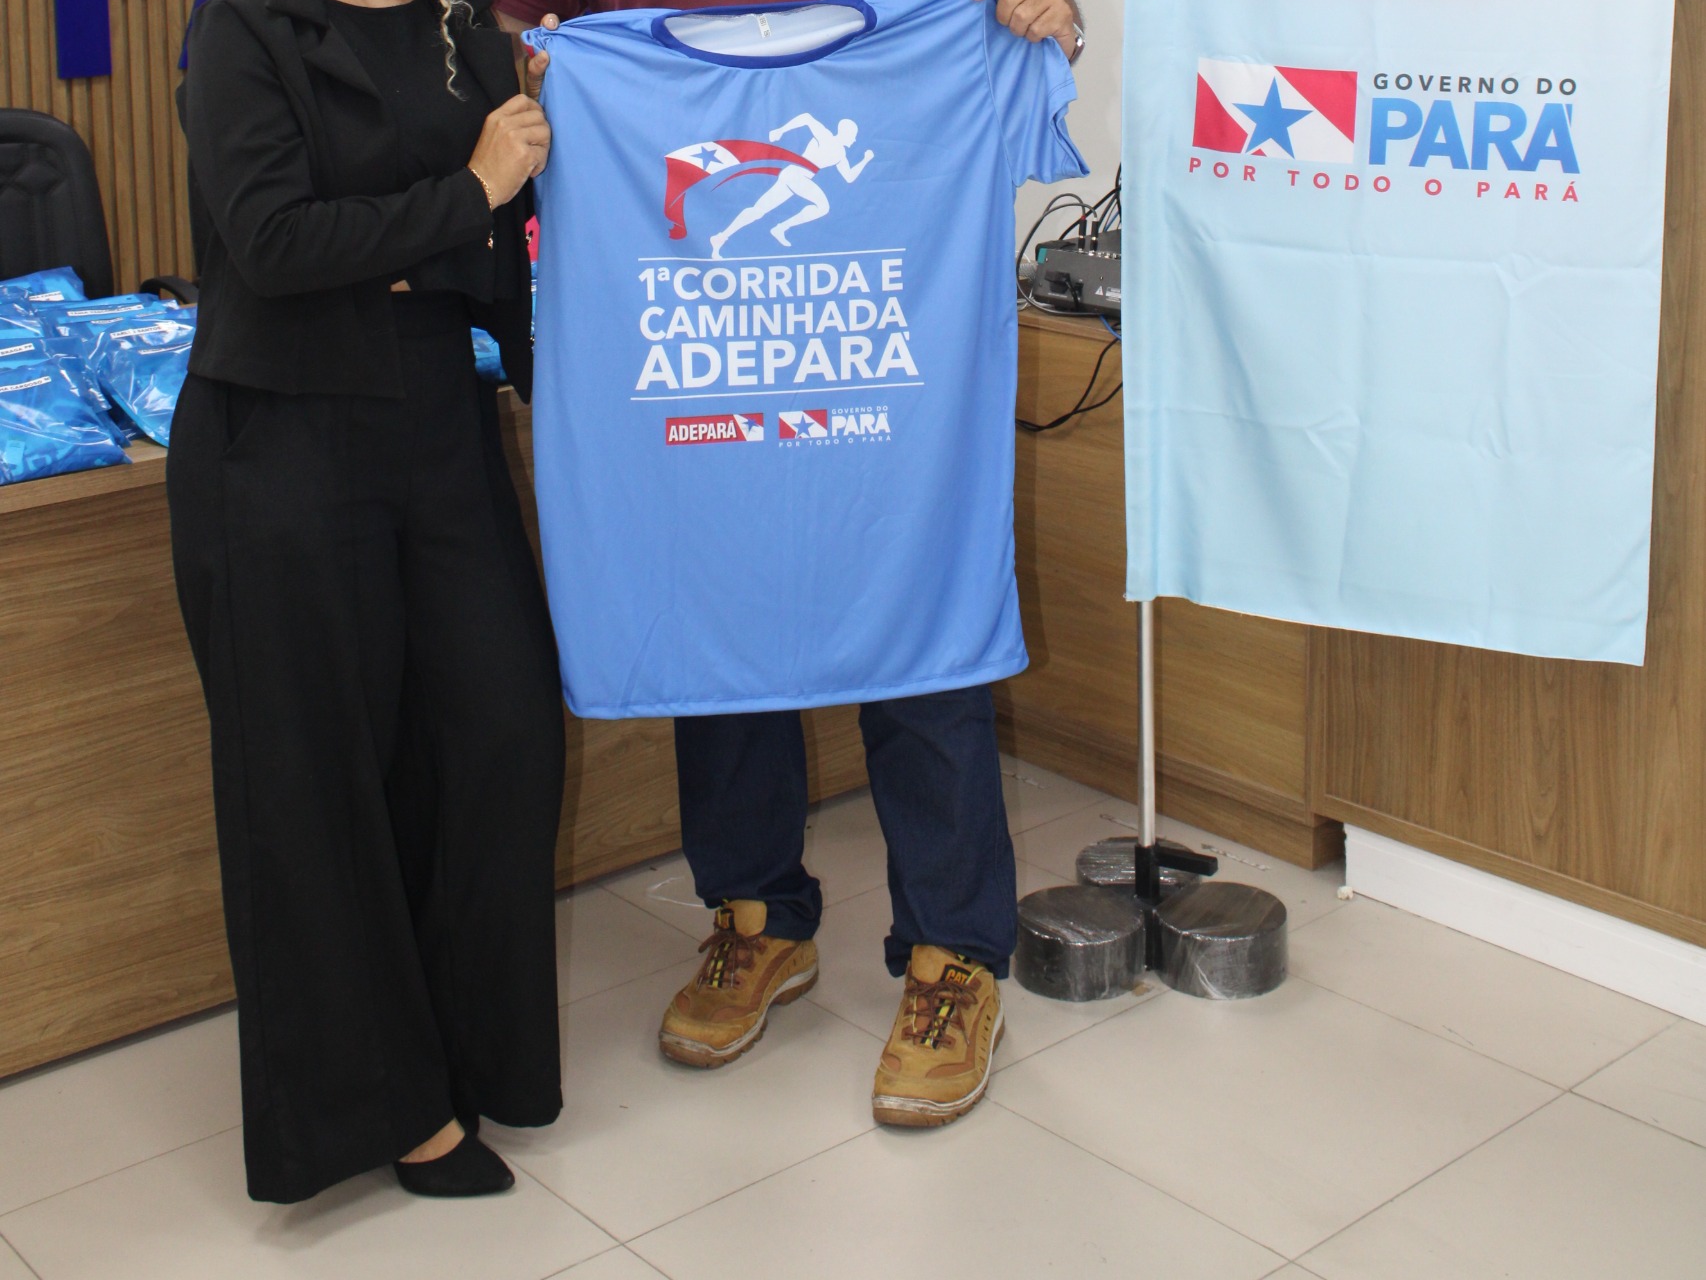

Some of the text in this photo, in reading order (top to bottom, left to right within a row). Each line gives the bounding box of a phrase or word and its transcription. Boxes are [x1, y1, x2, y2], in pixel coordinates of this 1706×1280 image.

[1373, 72, 1577, 96] GOVERNO DO
[1368, 97, 1581, 174] PARÁ
[1189, 156, 1580, 203] POR TODO O PARÁ
[881, 258, 904, 291] E
[639, 296, 908, 341] CAMINHADA
[635, 331, 919, 390] ADEPARÁ
[832, 405, 888, 415] GOVERNO DO
[668, 420, 737, 442] ADEPARÁ
[831, 412, 891, 437] PARÁ
[808, 438, 840, 447] TODO
[945, 968, 968, 985] CAT
